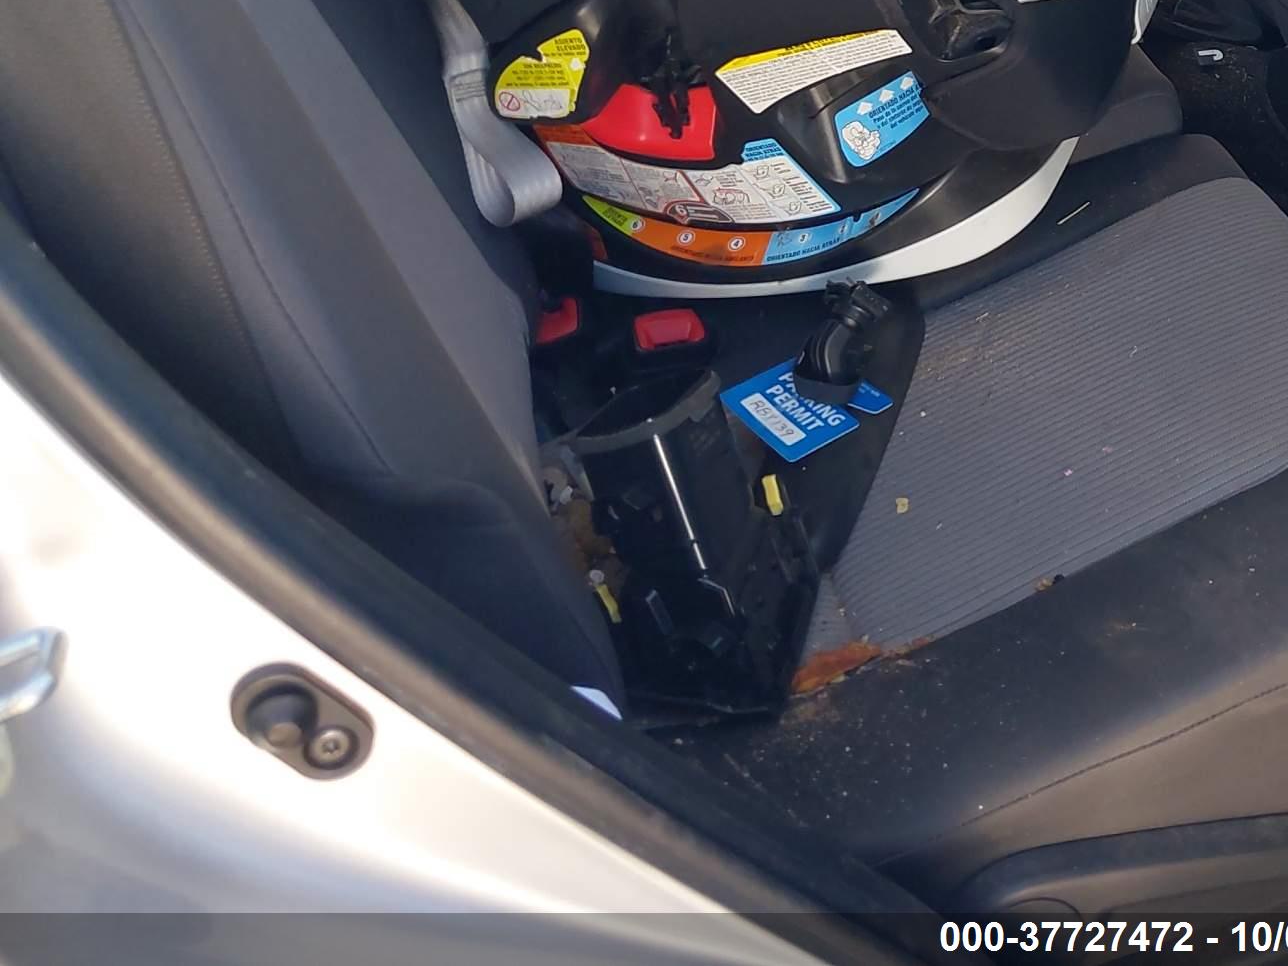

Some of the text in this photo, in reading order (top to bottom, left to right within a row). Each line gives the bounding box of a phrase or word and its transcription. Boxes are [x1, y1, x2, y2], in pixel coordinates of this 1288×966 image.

[868, 97, 899, 119] ORIENTADO
[898, 86, 915, 102] HACIA
[675, 204, 688, 215] 6
[766, 250, 801, 262] ORIENTADO
[802, 244, 821, 255] HACIA
[765, 385, 825, 431] PERMIT
[778, 371, 847, 427] PAKING
